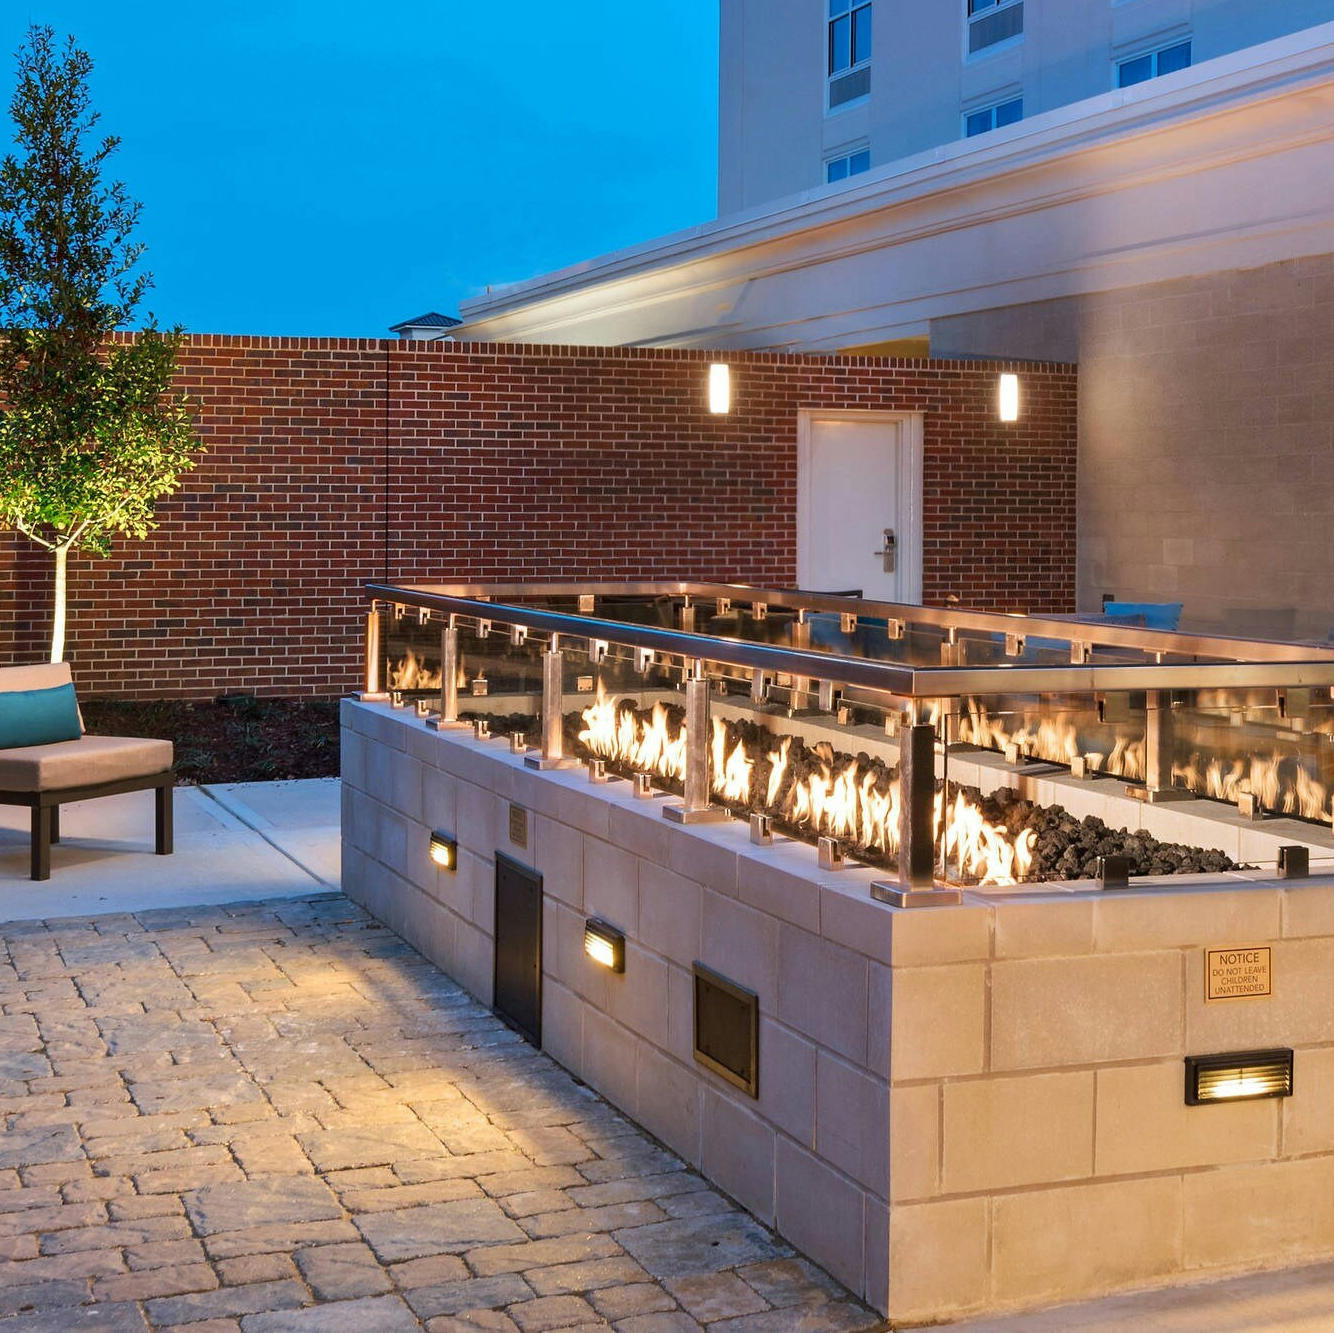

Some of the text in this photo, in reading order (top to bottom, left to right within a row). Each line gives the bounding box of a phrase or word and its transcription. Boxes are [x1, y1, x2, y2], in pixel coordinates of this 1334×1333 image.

[1219, 952, 1260, 965] NOTICE
[1212, 966, 1266, 976] DO NOT LEAVE
[1221, 975, 1258, 985] CHILDREN
[1214, 983, 1264, 994] UNATTENDED
